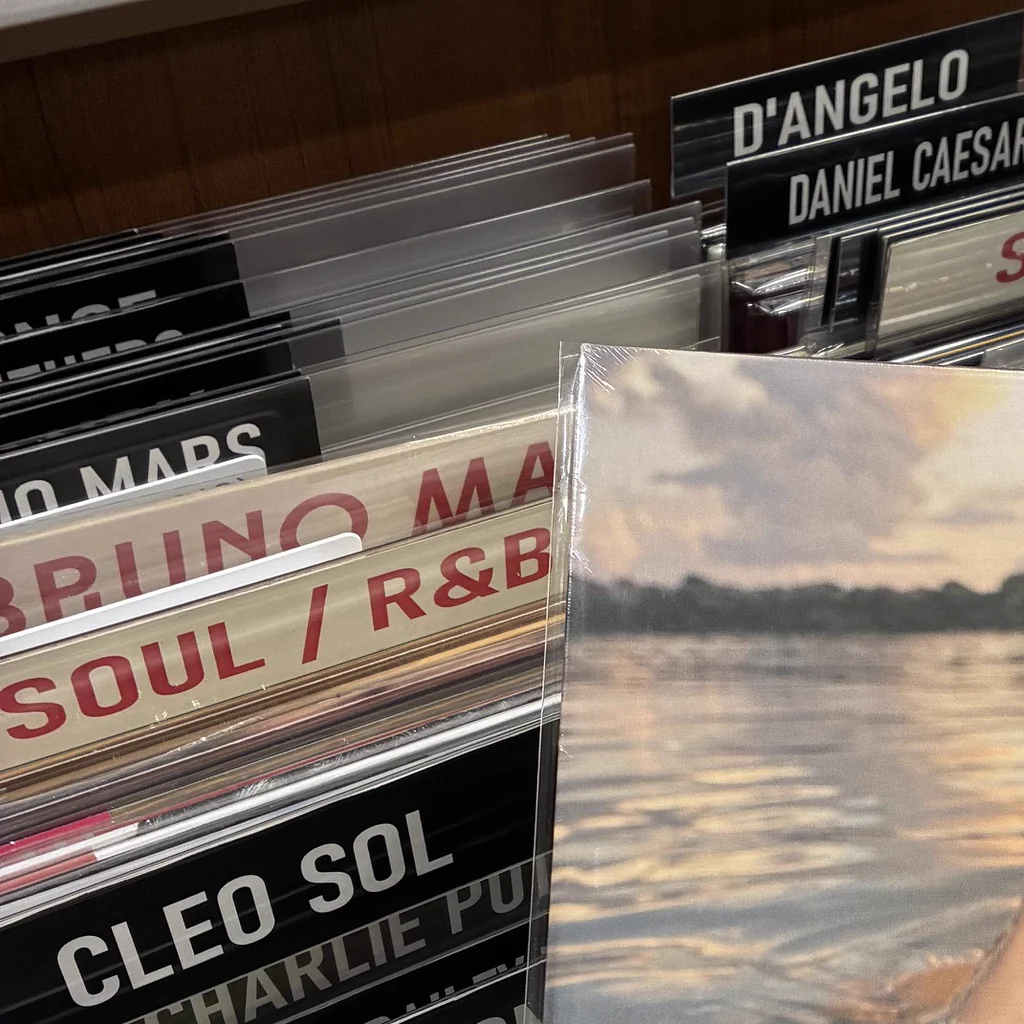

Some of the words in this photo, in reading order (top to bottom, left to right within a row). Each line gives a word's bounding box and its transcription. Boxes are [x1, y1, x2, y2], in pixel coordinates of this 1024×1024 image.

[733, 49, 970, 158] D'ANGELO
[788, 150, 901, 226] DANIEL
[0, 622, 267, 740] SOUL
[302, 583, 329, 665] /
[367, 526, 554, 633] R&B
[57, 873, 277, 1008] CLEO
[299, 808, 454, 914] SOL
